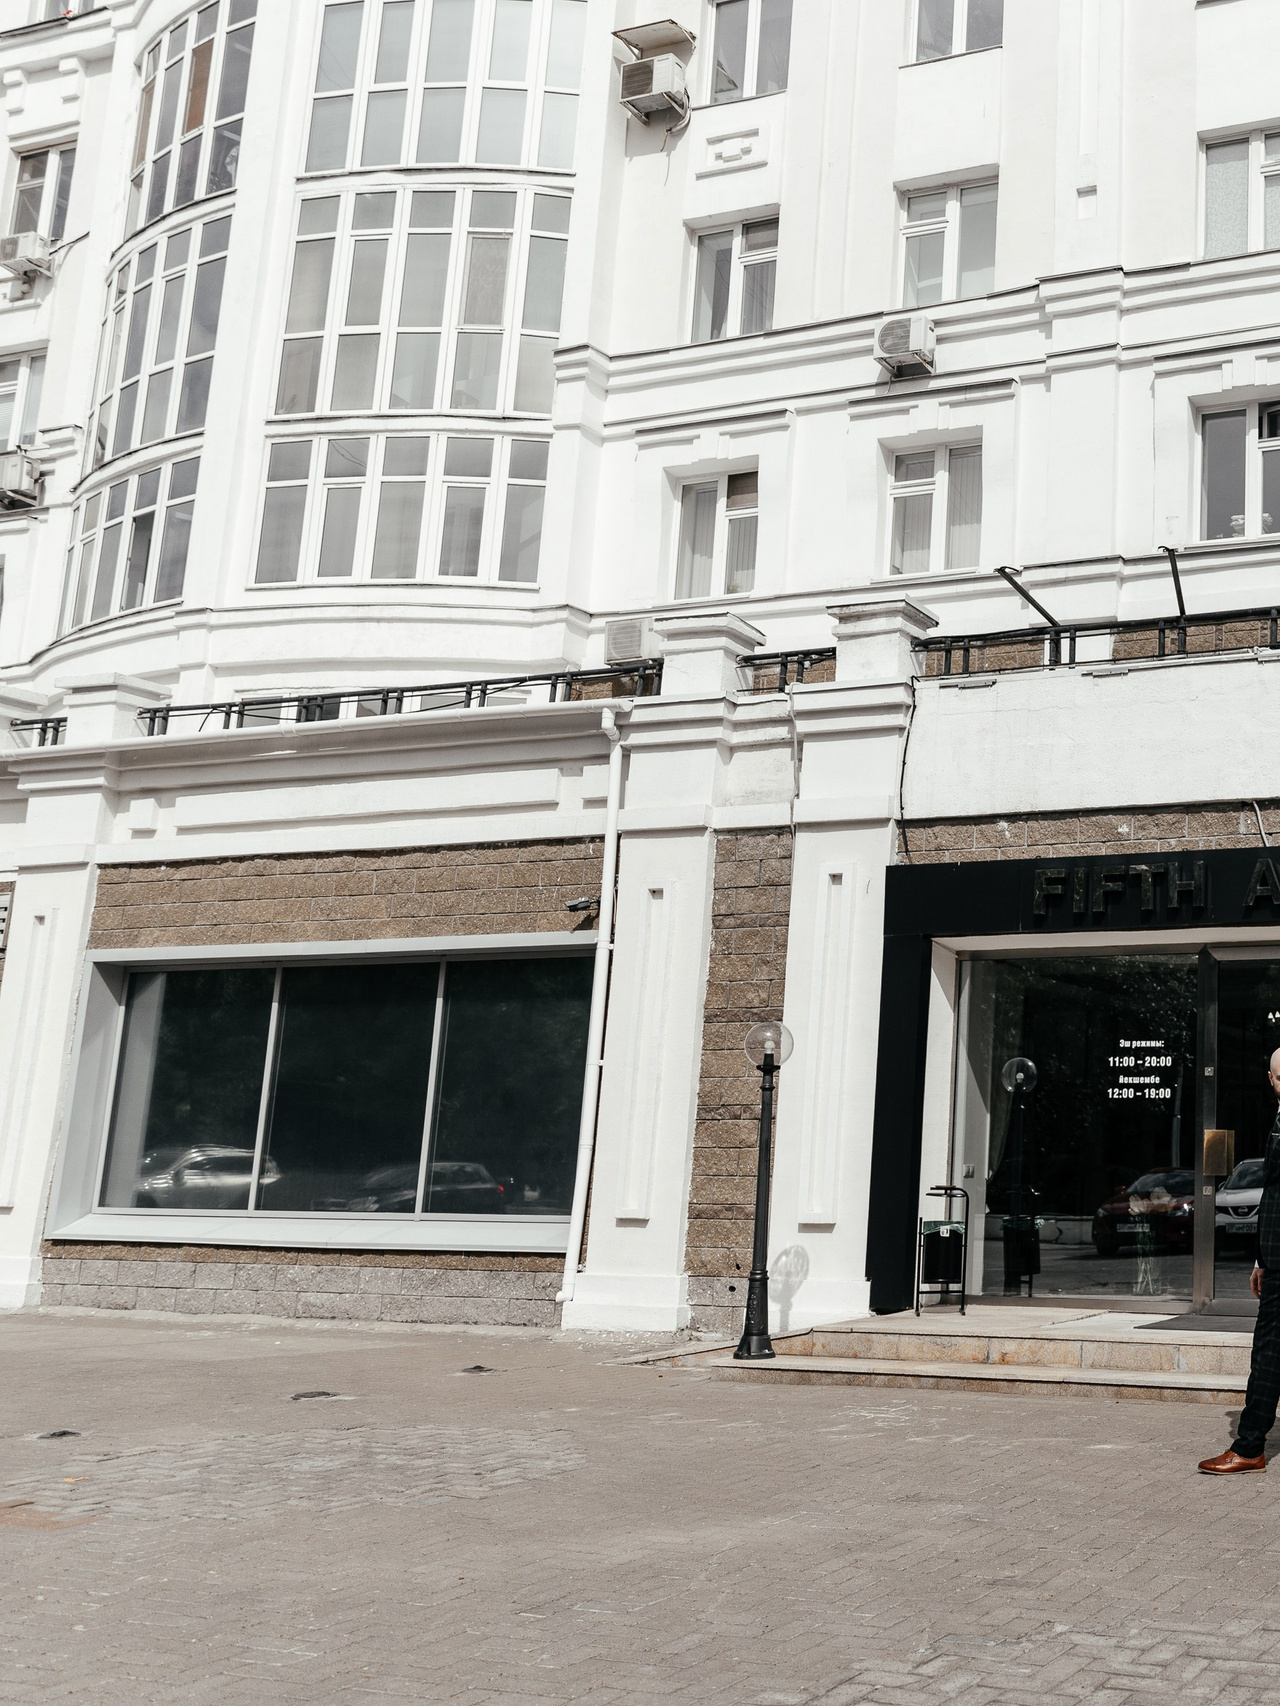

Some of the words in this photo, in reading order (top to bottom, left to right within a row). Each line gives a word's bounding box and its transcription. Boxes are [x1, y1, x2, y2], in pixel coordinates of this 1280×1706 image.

[1033, 860, 1205, 915] FIFTH
[1132, 1039, 1165, 1049] режимы:
[1108, 1056, 1135, 1067] 11:00
[1144, 1056, 1172, 1067] 20:00
[1107, 1088, 1135, 1099] 12:00
[1143, 1088, 1171, 1099] 19:00
